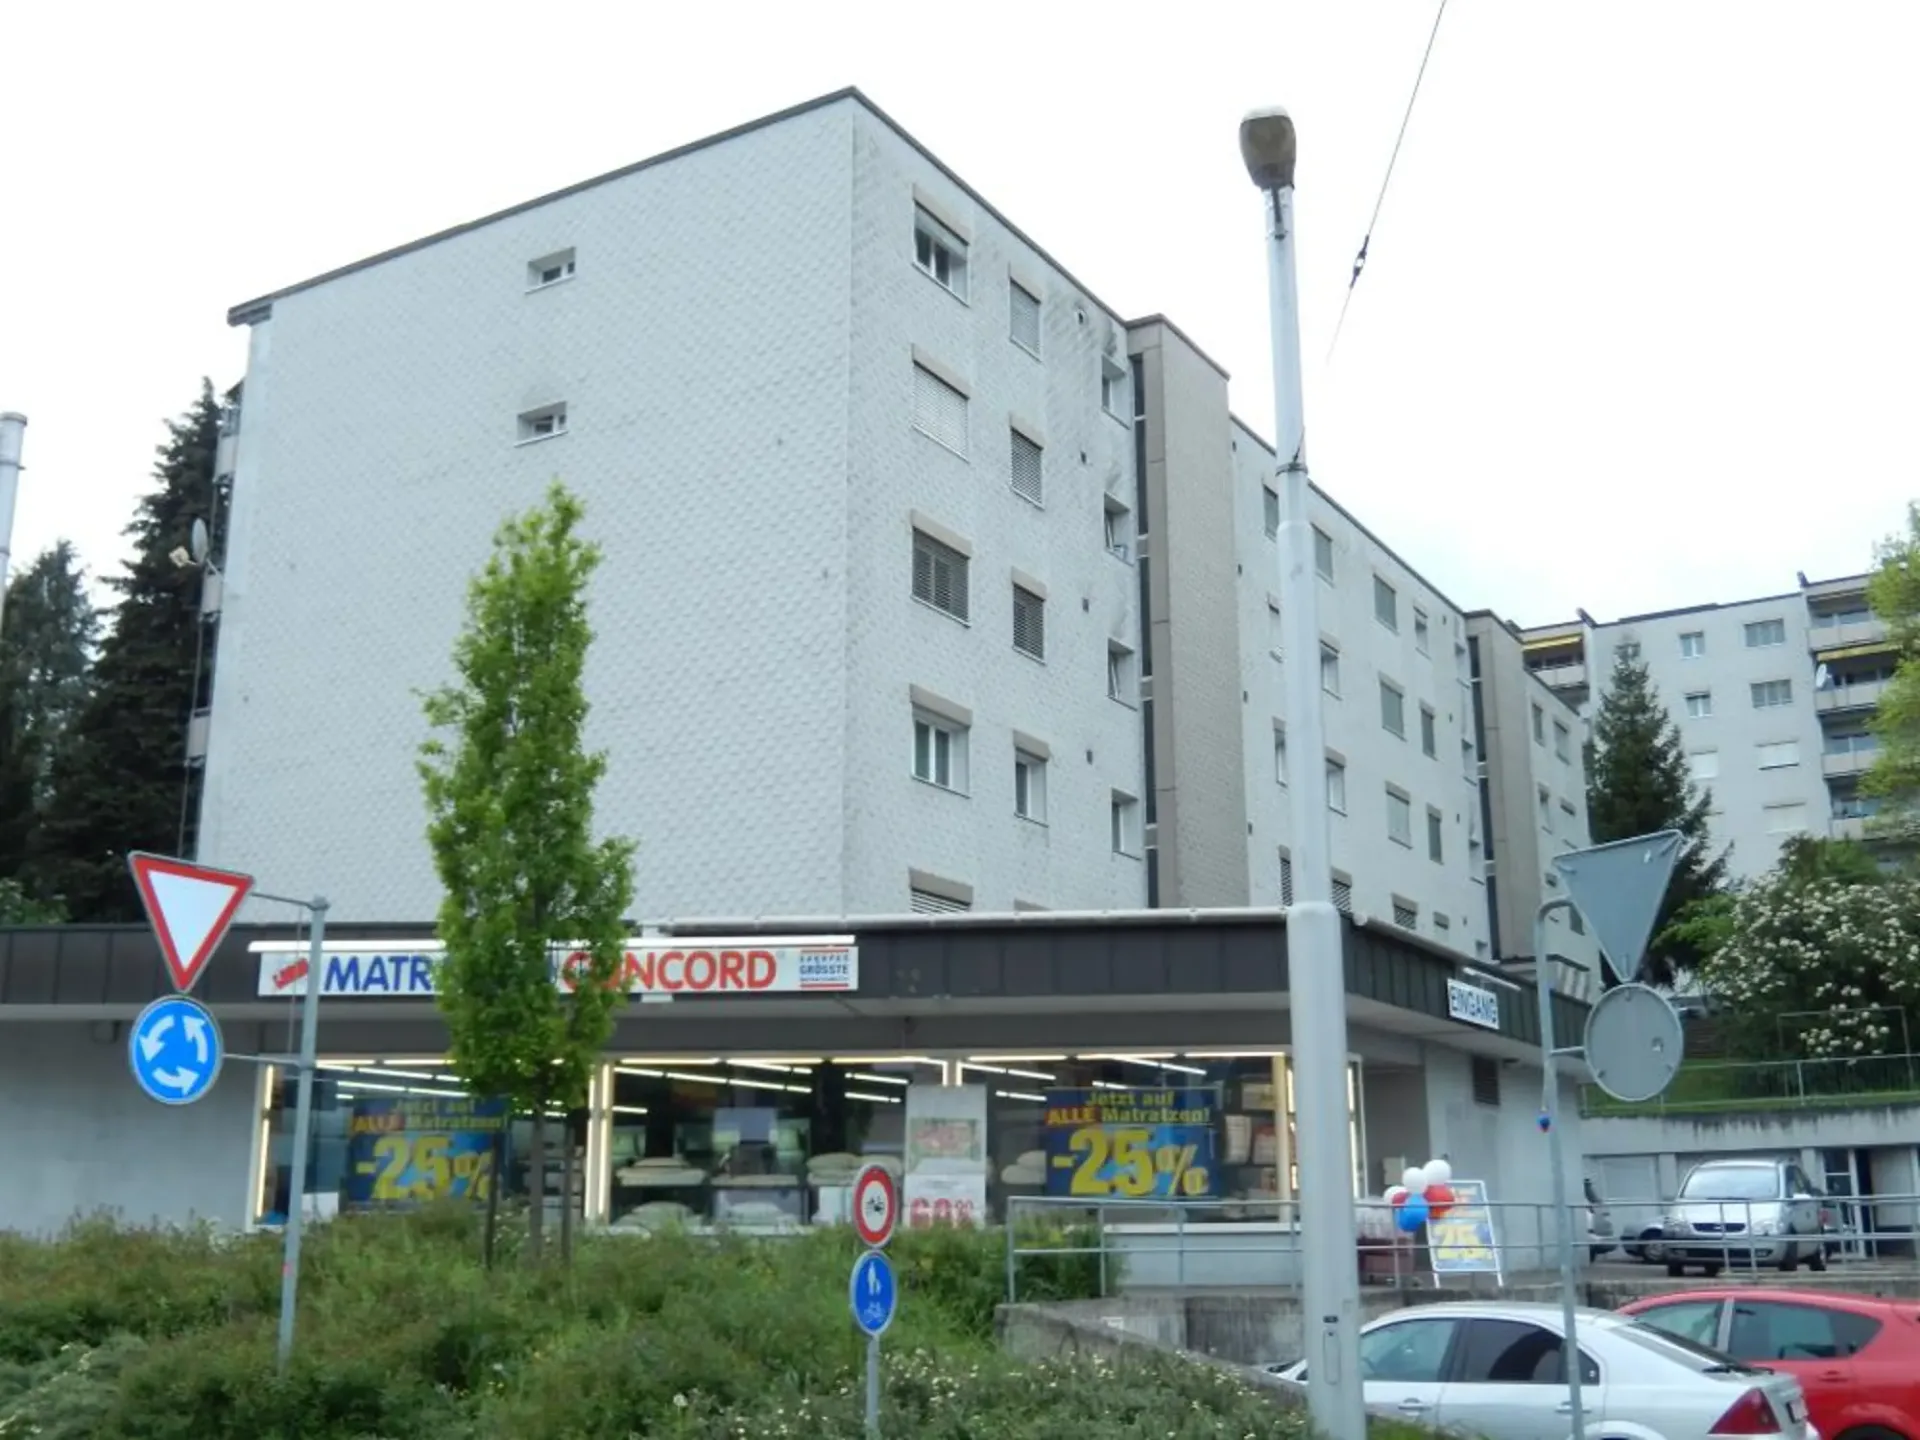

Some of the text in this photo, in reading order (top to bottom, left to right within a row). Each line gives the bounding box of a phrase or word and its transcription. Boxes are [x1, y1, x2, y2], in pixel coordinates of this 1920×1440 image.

[323, 956, 433, 991] MATR
[1450, 985, 1497, 1023] EINGANG
[1046, 1107, 1211, 1124] ALLE Matratzen!
[1087, 1090, 1175, 1106] Jetzt auf
[1052, 1127, 1210, 1197] -25%
